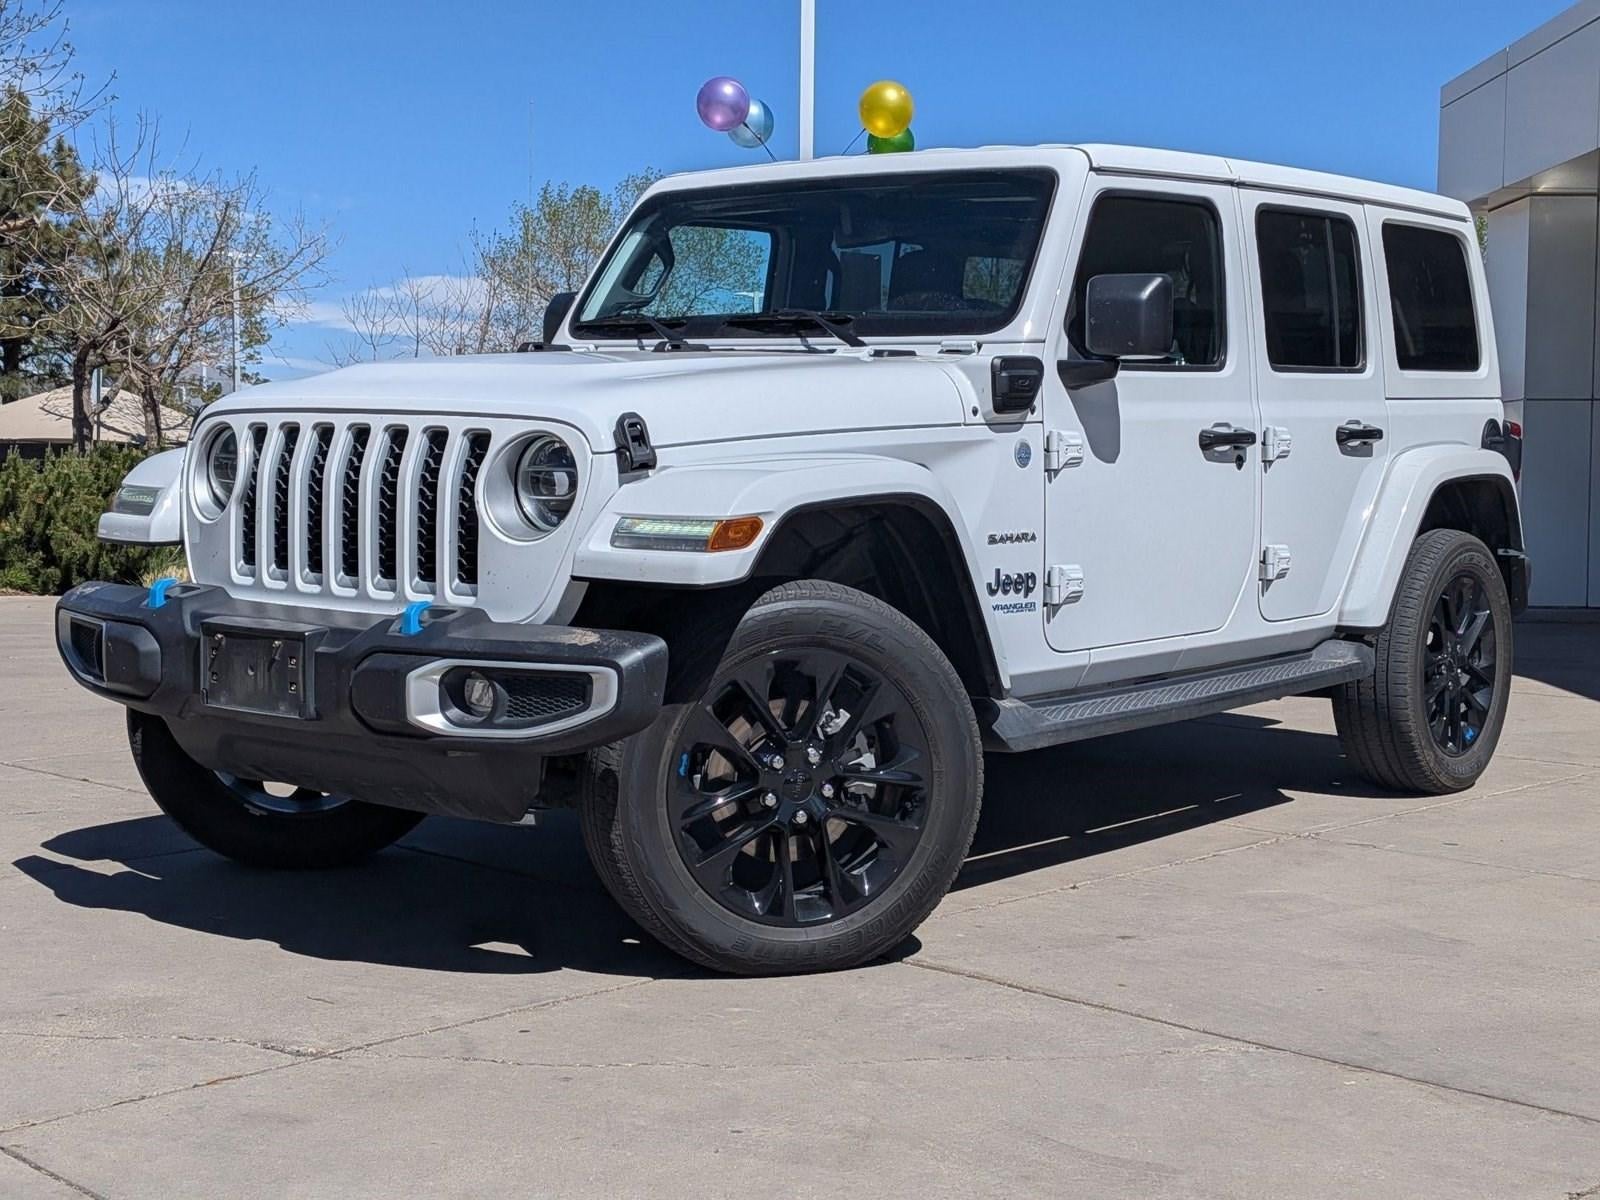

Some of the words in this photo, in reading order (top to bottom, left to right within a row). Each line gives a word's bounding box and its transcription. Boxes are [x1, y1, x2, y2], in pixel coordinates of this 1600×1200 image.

[987, 532, 1037, 546] SAHARA
[986, 568, 1037, 599] Jeep
[992, 602, 1036, 612] WRANGLER
